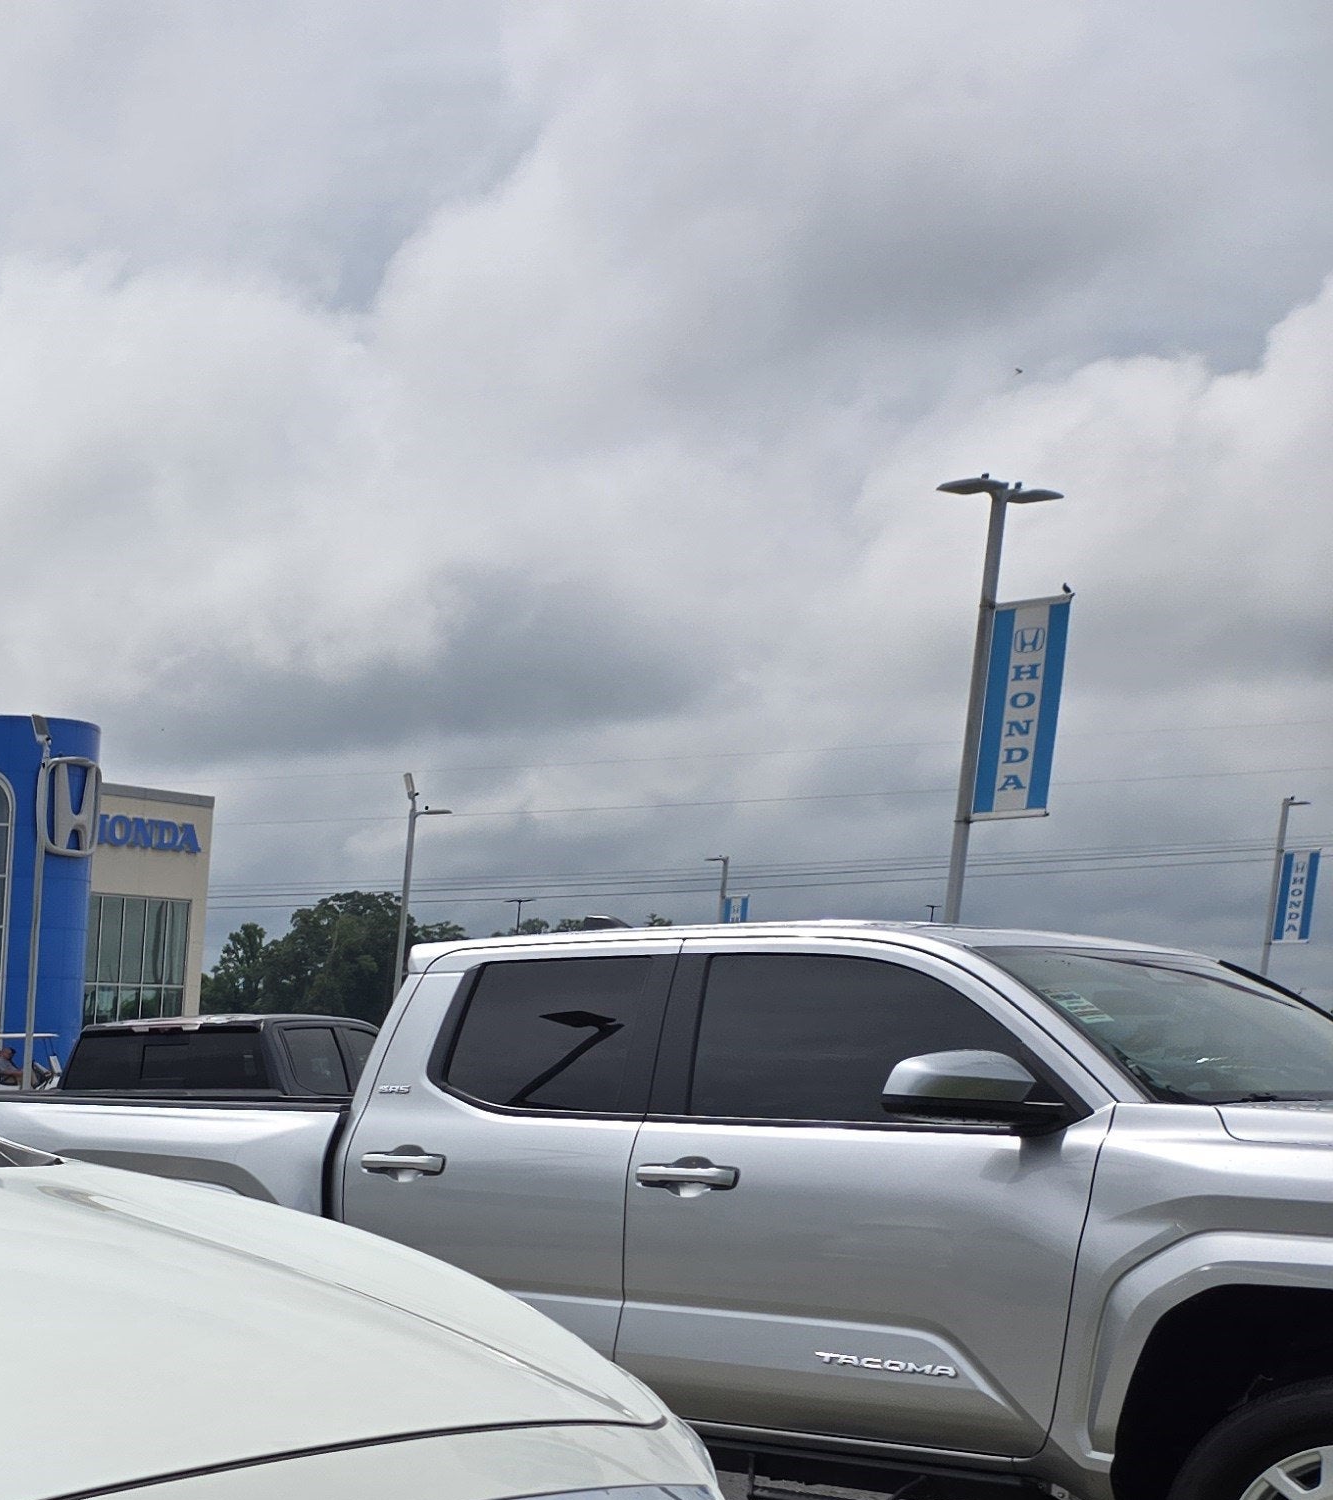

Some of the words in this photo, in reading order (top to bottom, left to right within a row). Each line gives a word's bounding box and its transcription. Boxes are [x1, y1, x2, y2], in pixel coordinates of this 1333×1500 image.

[997, 663, 1041, 791] HONDA
[1285, 876, 1305, 933] HONDA
[378, 1085, 412, 1094] SR5
[814, 1351, 959, 1378] TACOMA
